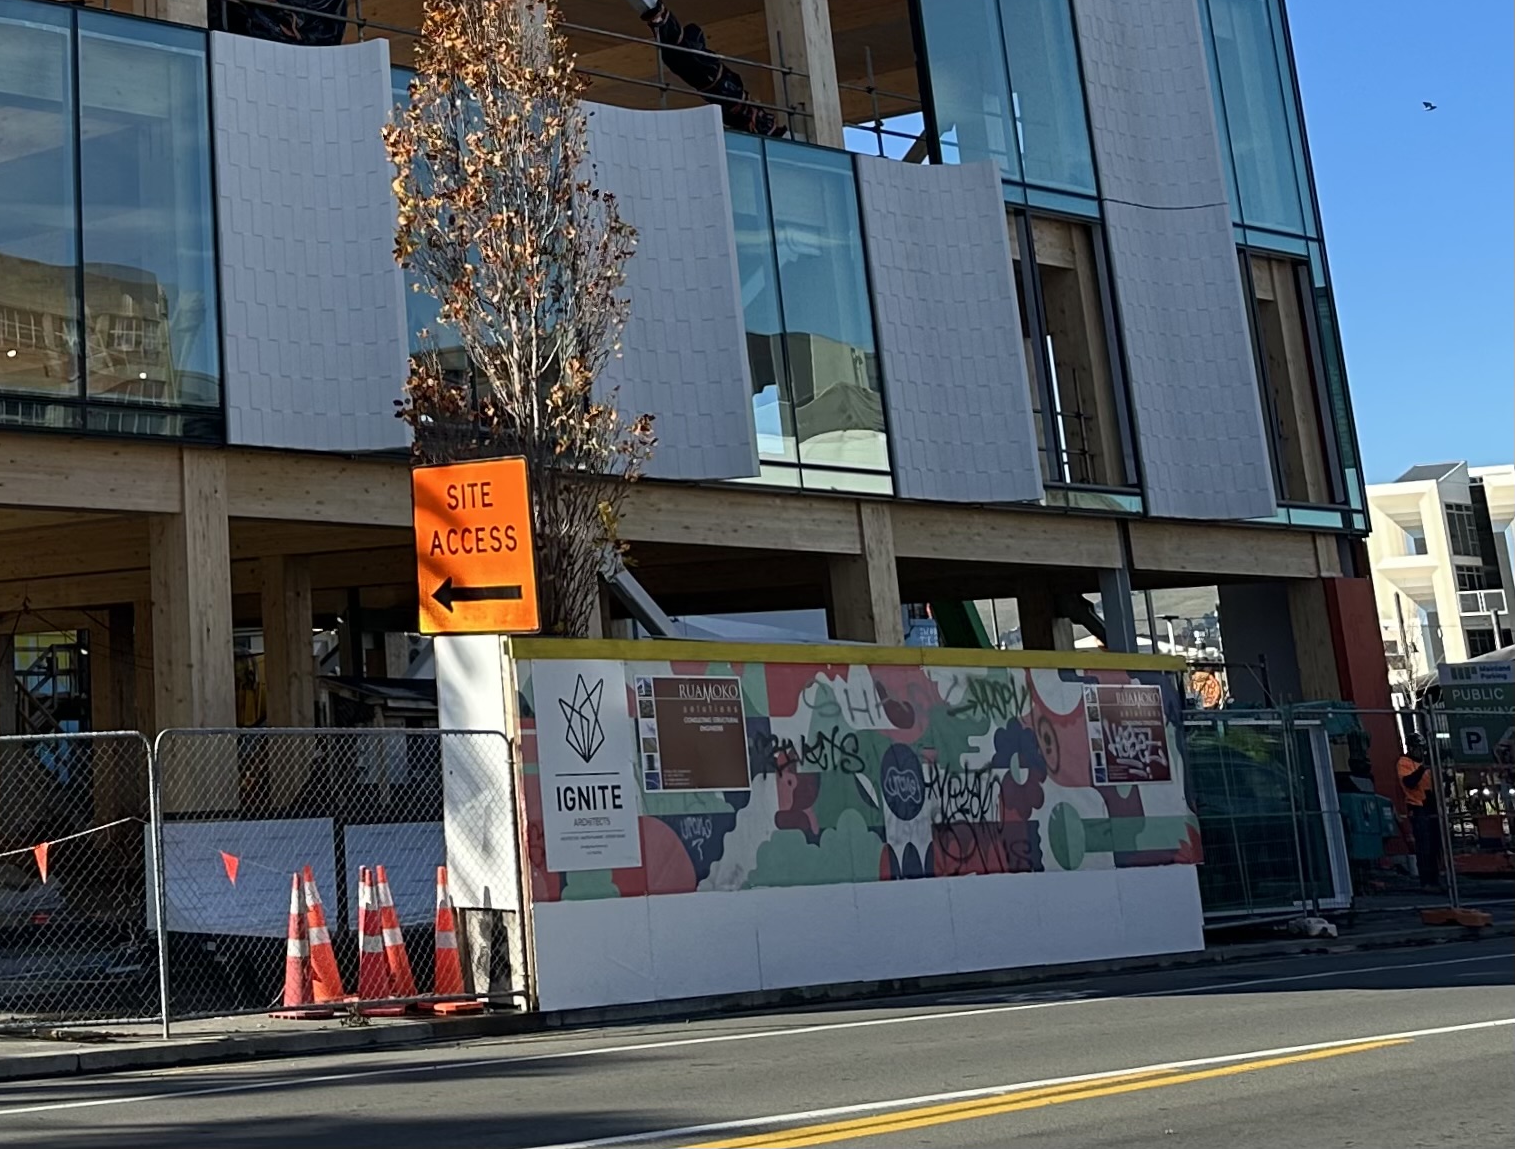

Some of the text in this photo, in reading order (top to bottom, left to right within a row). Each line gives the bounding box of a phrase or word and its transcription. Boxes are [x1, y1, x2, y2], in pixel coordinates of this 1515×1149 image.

[447, 482, 493, 511] SITE
[430, 525, 518, 557] ACCESS
[678, 682, 738, 704] RUAMOKO
[1452, 687, 1504, 701] PUBLIC
[1466, 731, 1482, 751] P
[556, 784, 624, 812] IGNITE
